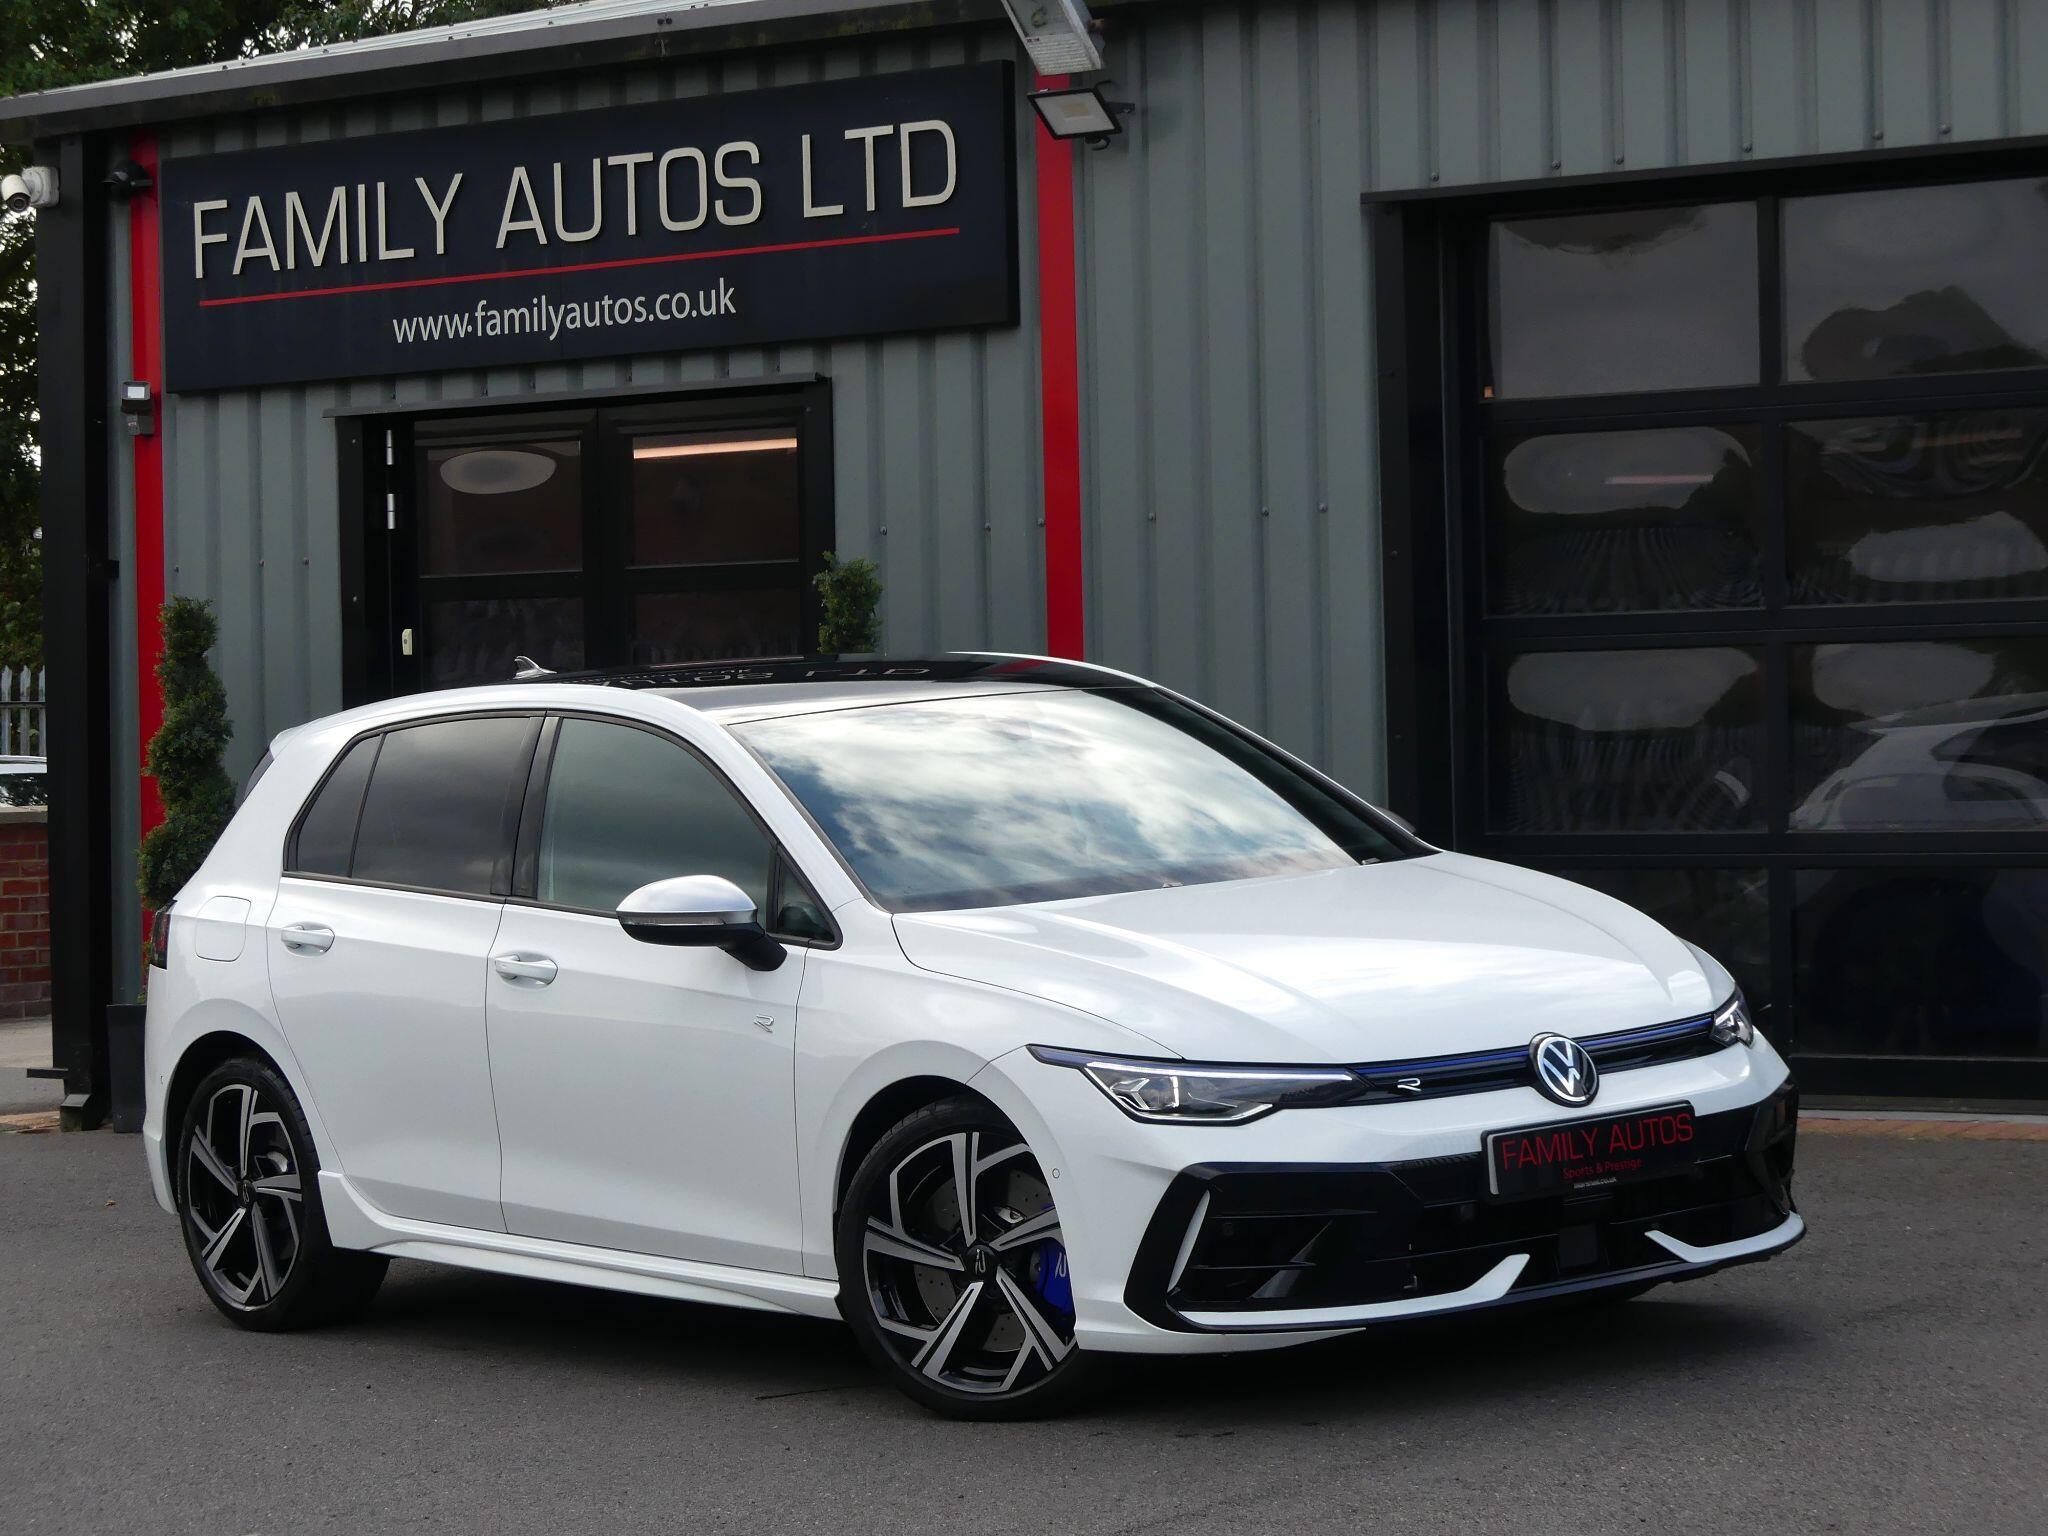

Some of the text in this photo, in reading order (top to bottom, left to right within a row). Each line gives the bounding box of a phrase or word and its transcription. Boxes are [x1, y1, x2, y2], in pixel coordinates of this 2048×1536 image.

[193, 119, 957, 279] FAMILY AUTOS LTD
[392, 277, 737, 342] www.familyautos.co.uk
[1397, 1077, 1422, 1092] R
[1502, 1112, 1694, 1171] FAMILY AUTOS
